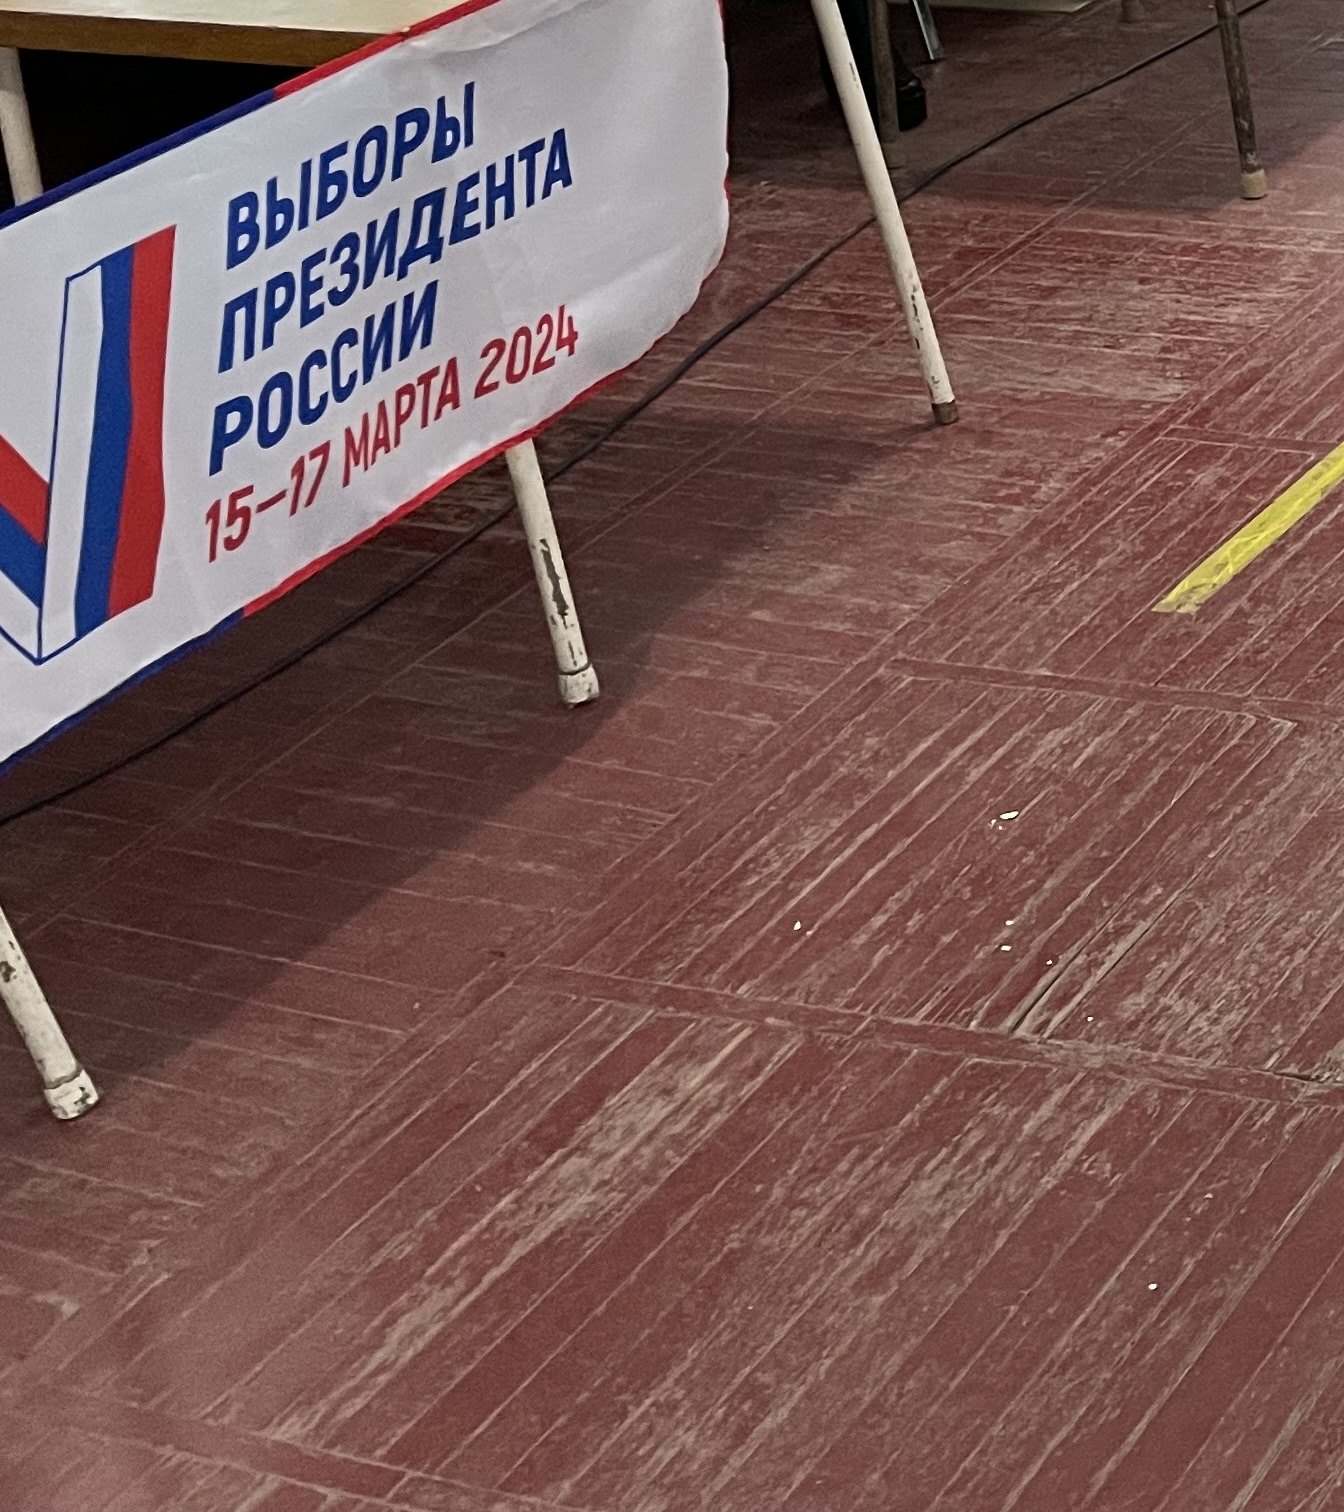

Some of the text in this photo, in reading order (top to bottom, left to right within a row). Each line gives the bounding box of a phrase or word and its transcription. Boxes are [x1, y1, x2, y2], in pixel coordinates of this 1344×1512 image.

[218, 128, 574, 374] ПРЕЗИДЕНТА
[226, 81, 477, 271] ВЫБОРЫ
[209, 280, 438, 477] РОССИИ
[341, 357, 461, 489] МАРТА
[474, 304, 579, 401] 2024
